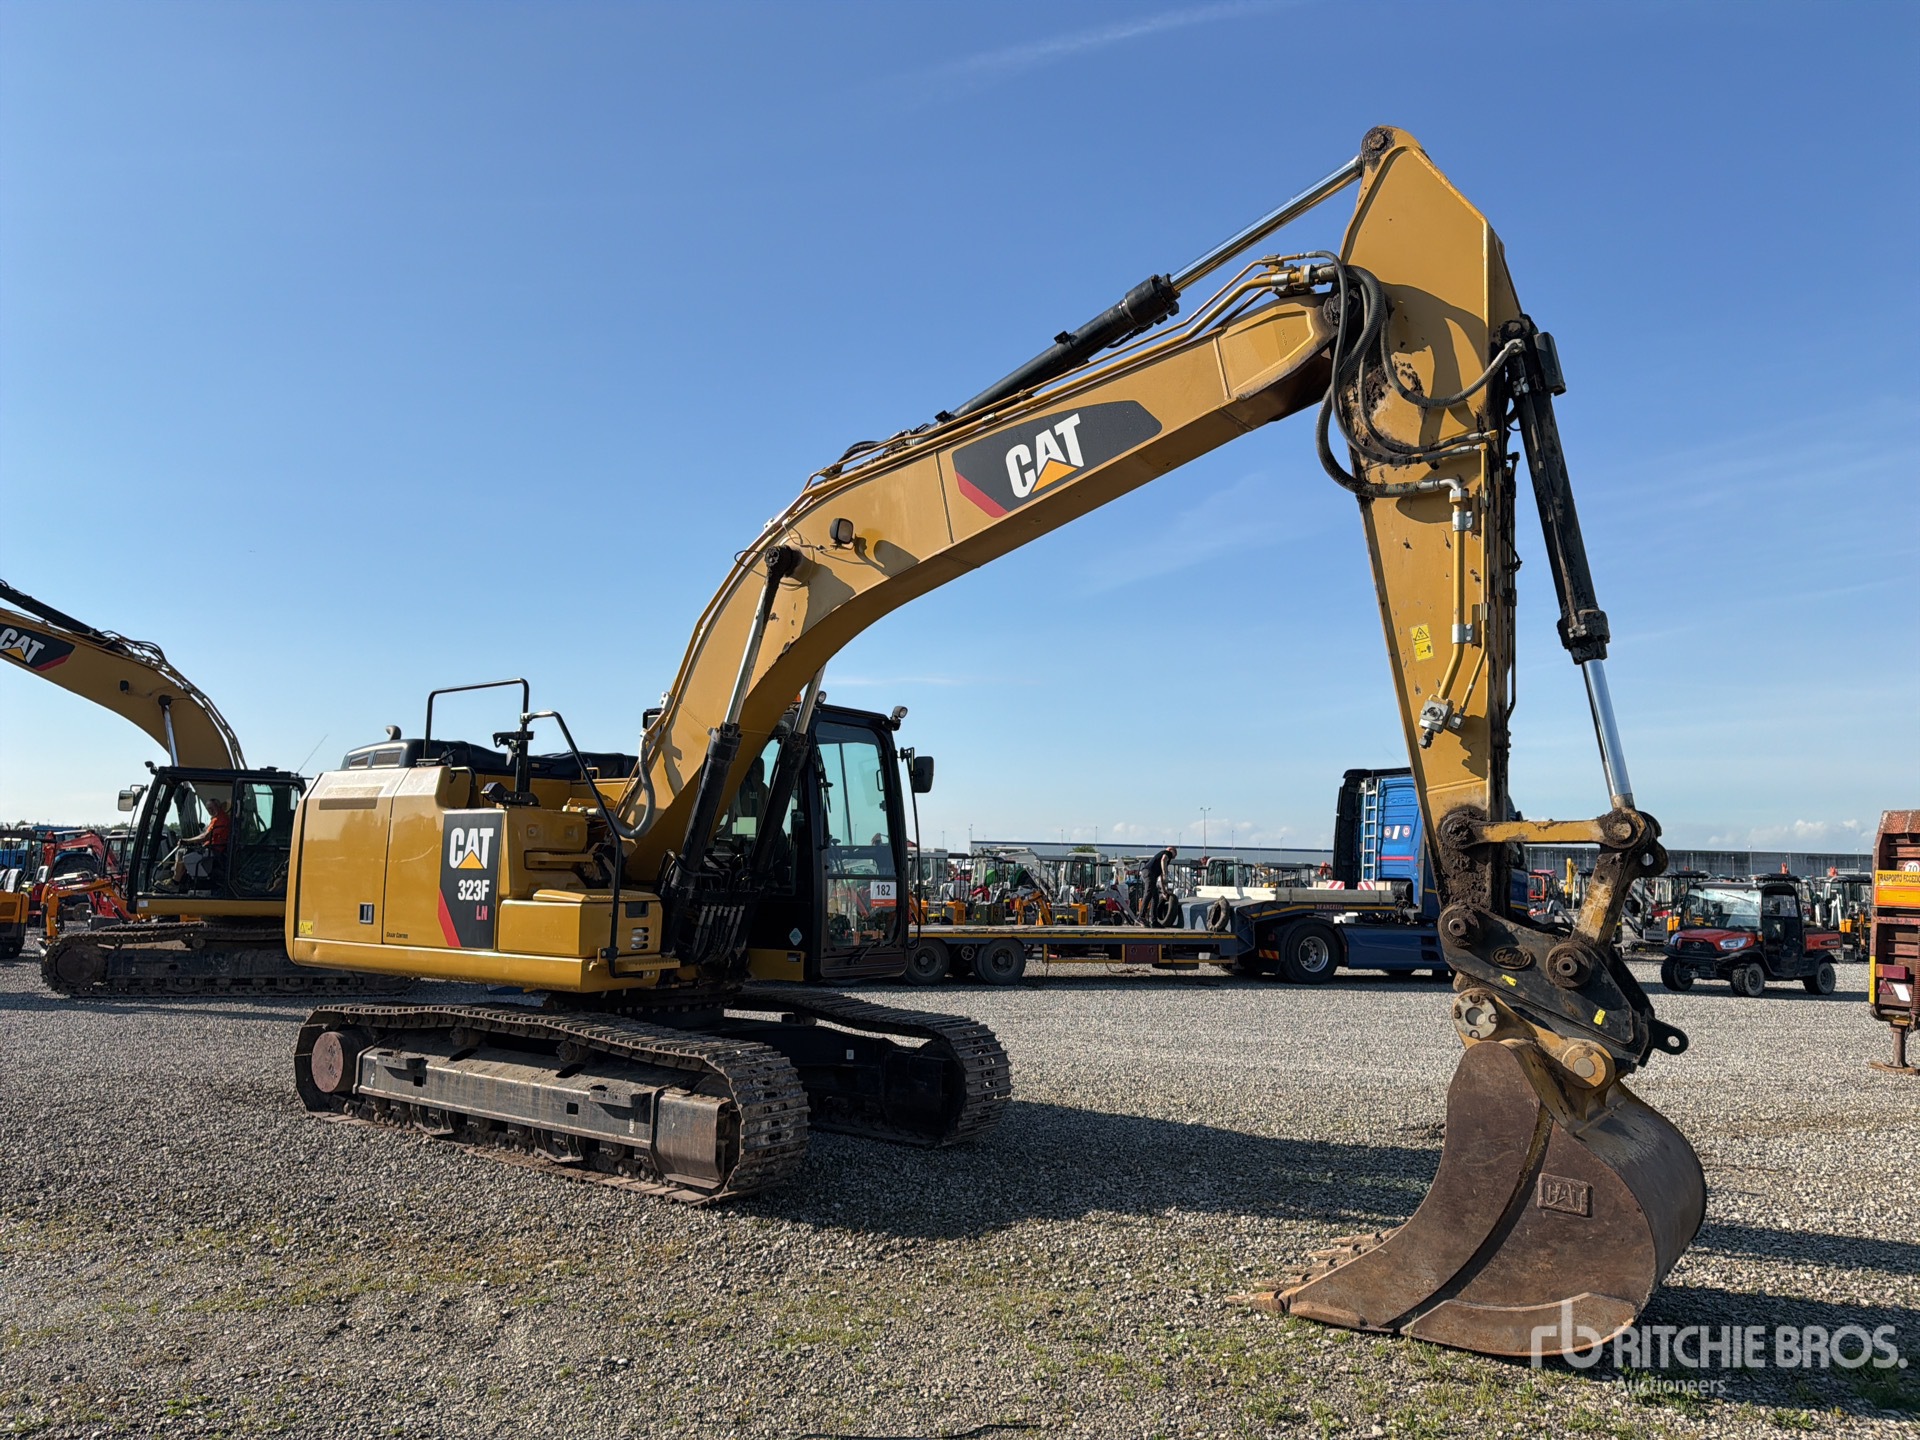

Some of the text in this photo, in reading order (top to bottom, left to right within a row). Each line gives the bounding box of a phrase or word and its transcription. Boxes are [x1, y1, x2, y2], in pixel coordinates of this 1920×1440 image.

[1005, 413, 1084, 498] CAT
[0, 628, 46, 664] CAT
[449, 827, 494, 870] CAT
[457, 879, 490, 901] 323F
[876, 884, 891, 896] 182
[476, 905, 488, 920] LN
[1542, 1180, 1587, 1211] CAT
